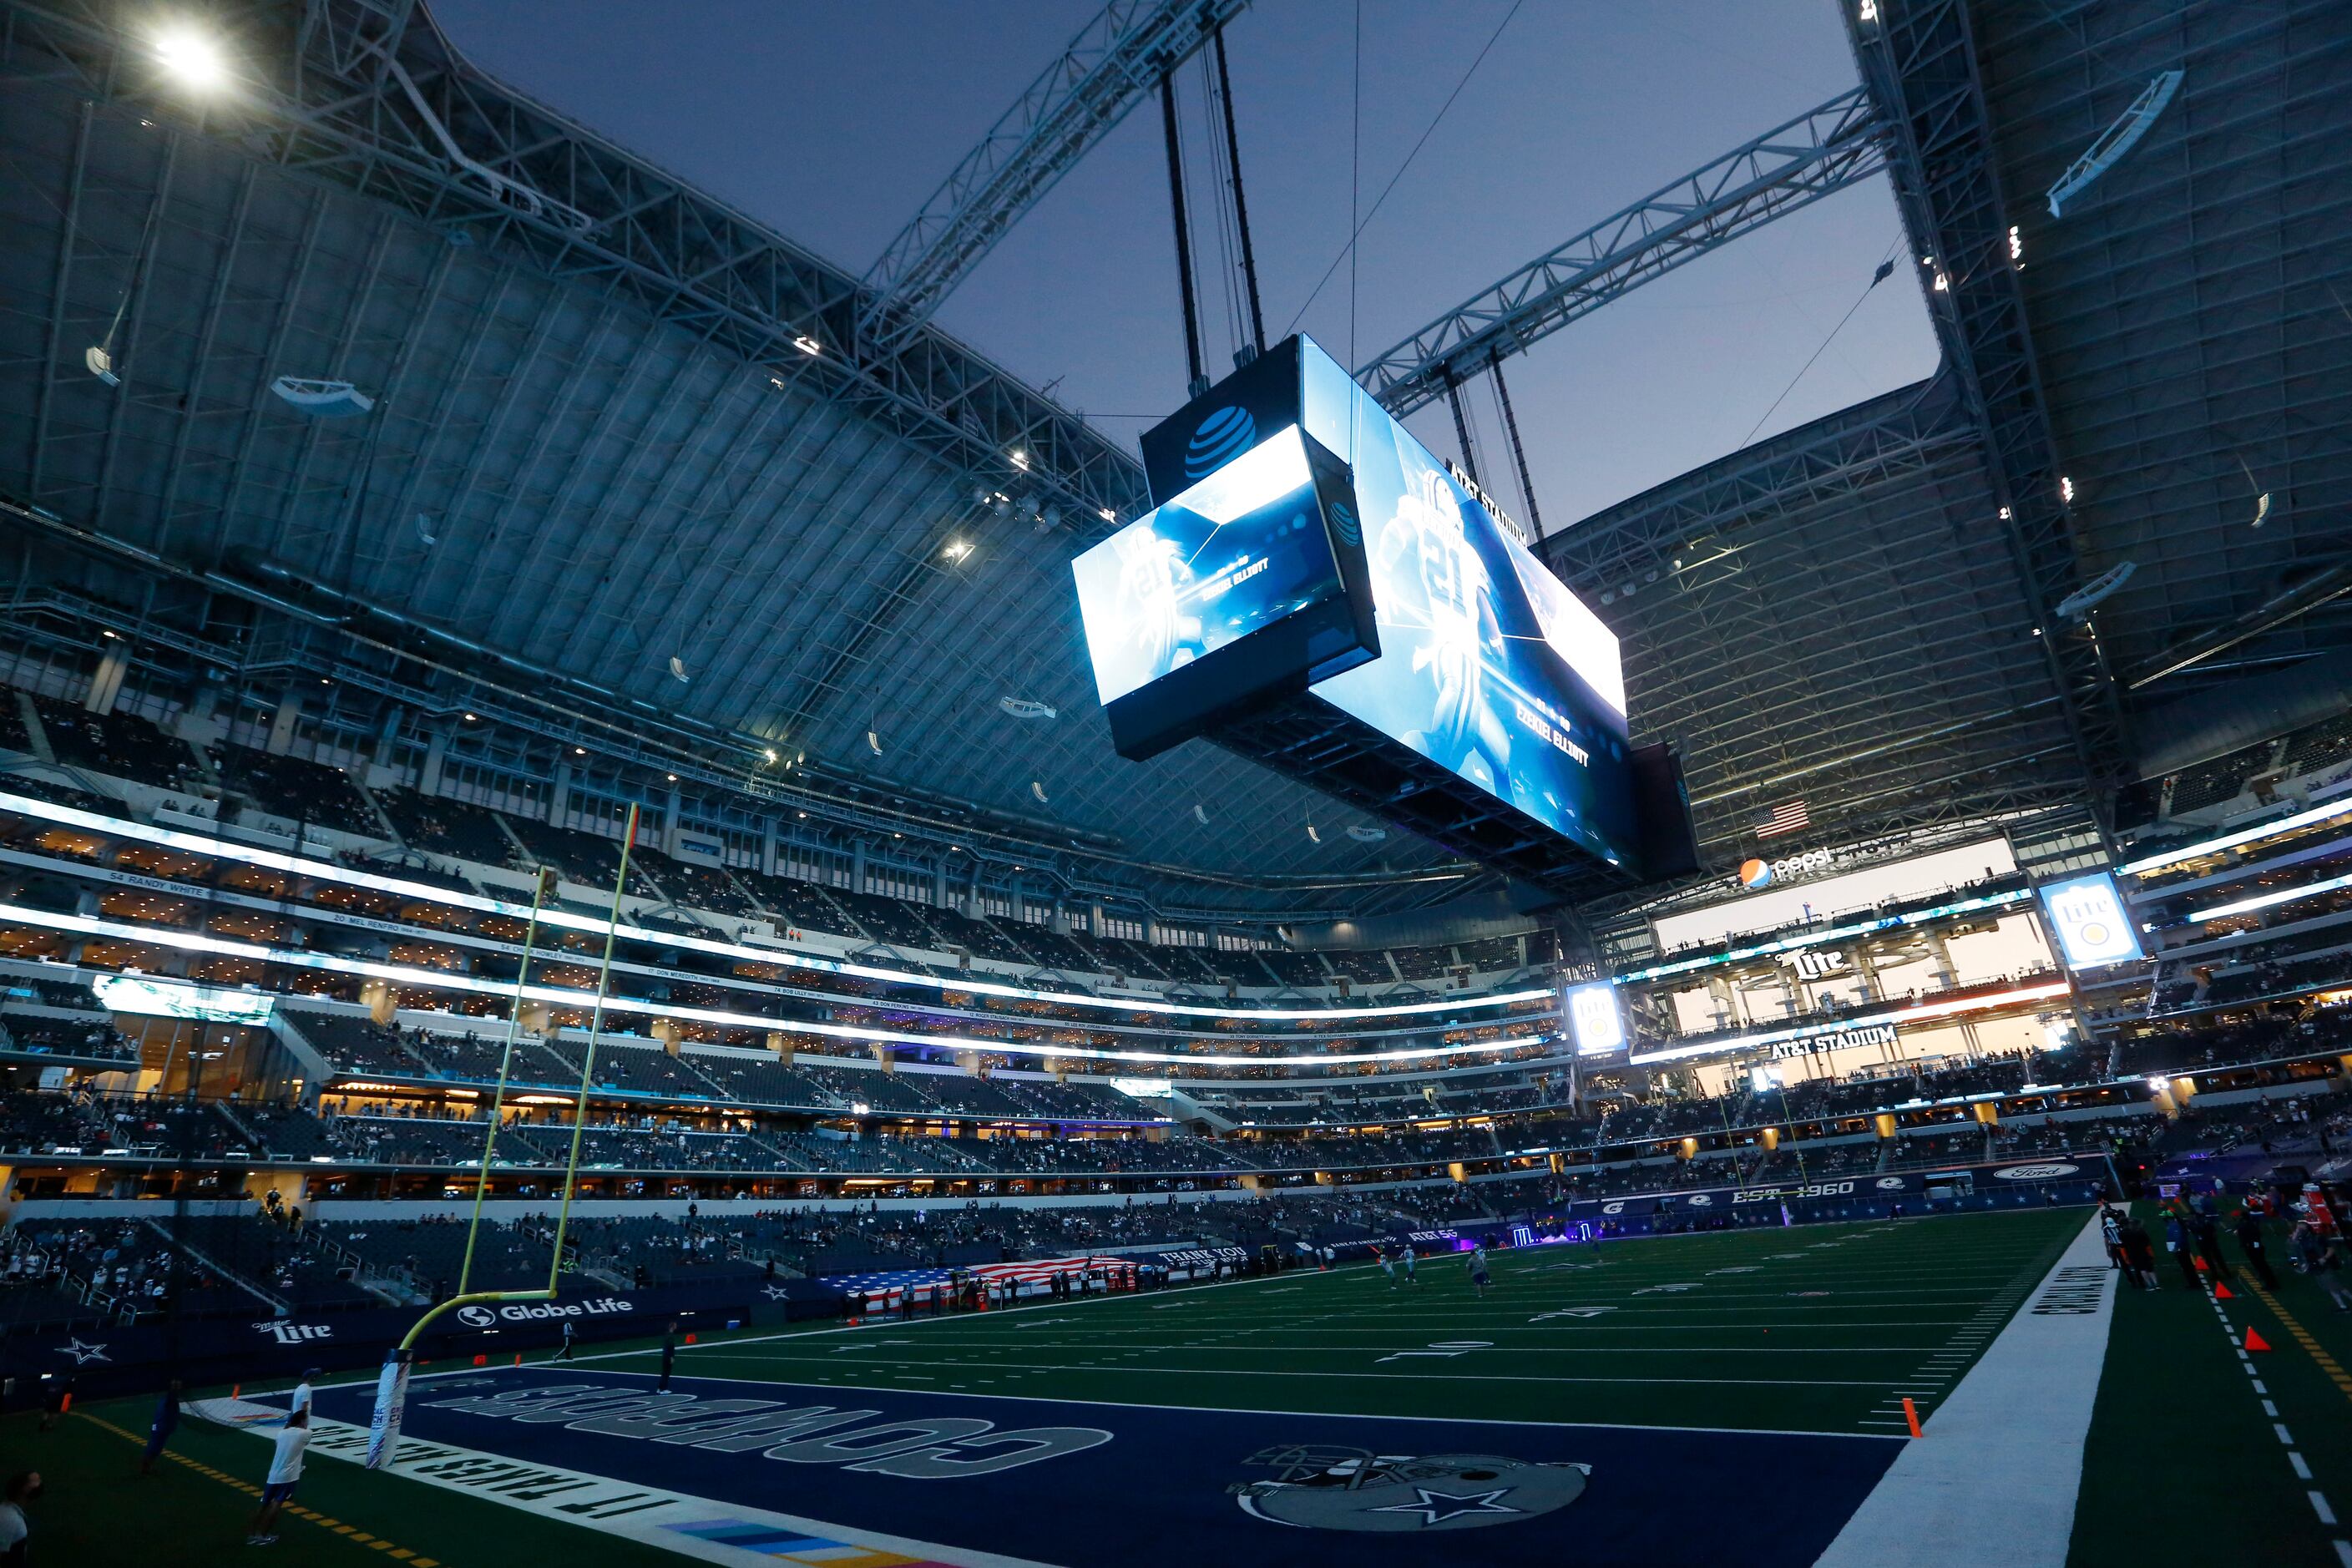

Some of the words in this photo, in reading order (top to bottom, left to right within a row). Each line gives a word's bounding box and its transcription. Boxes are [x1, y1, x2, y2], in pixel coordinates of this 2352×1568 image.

[1451, 462, 1479, 501] AT&T
[1481, 491, 1527, 548] STADIUM
[1424, 528, 1468, 618] 21
[1553, 729, 1589, 767] ELLIOTT
[1774, 846, 1833, 878] pepsi
[109, 873, 124, 881] 54
[129, 876, 167, 889] RANDY
[170, 883, 203, 896] WHITE
[349, 917, 366, 926] MEL
[367, 920, 399, 932] RENFRO
[670, 972, 698, 980] MEREDITH
[1793, 951, 1844, 980] Lite
[1772, 1039, 1813, 1060] AT&T
[1814, 1024, 1898, 1054] STADIUM
[2011, 1166, 2061, 1177] Ford
[1796, 1181, 1854, 1198] 1960
[1408, 1231, 1440, 1242] AT&T
[1438, 1229, 1458, 1238] 5G
[1158, 1249, 1216, 1262] THANK
[1211, 1247, 1247, 1257] YOU
[500, 1303, 583, 1321] Globe
[582, 1297, 634, 1314] Life
[2031, 1283, 2105, 1315] CRUCIAL
[251, 1319, 291, 1333] Miller
[273, 1325, 331, 1344] Lite
[415, 1384, 1115, 1479] COWBOYS
[417, 1458, 599, 1502] TAKES
[554, 1492, 680, 1520] IT
